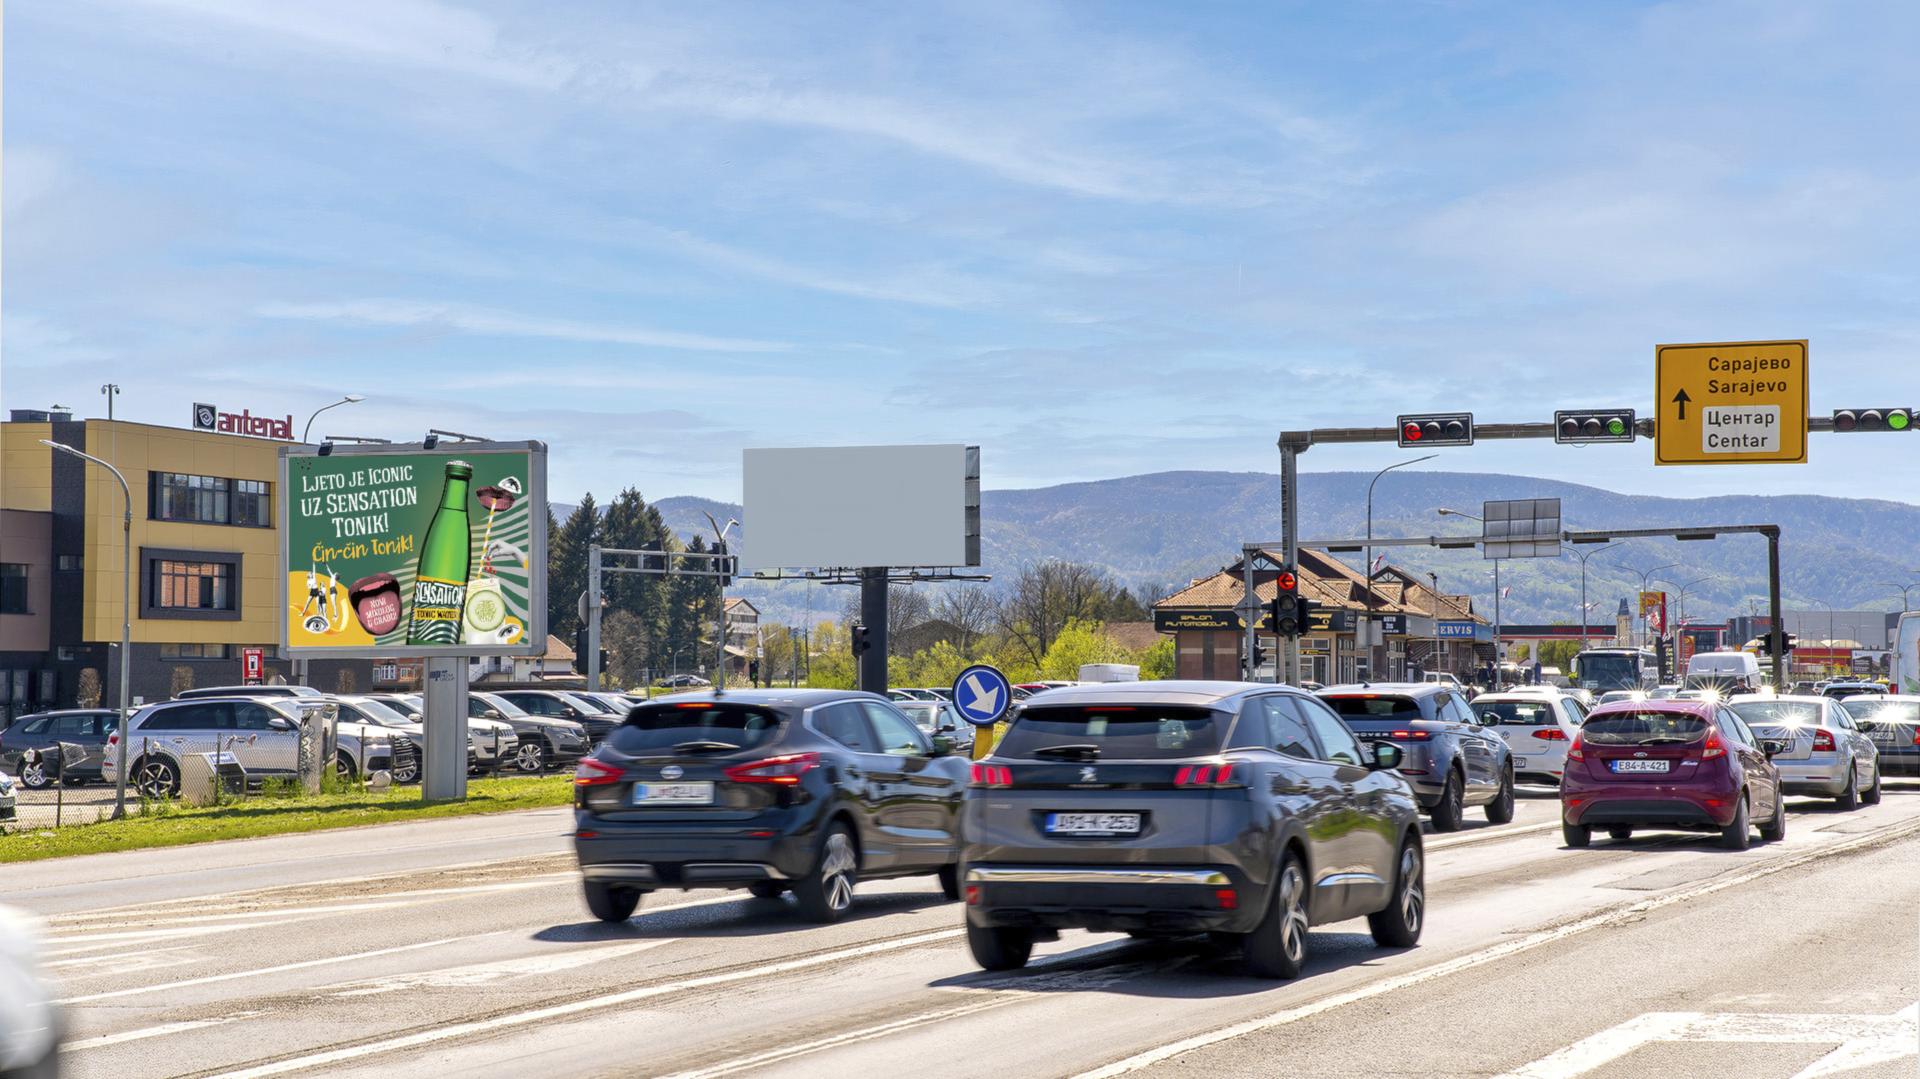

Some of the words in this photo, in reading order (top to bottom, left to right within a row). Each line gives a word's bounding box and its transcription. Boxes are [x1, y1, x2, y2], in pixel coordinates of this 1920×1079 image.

[1708, 356, 1791, 374] Сарајево
[1708, 379, 1787, 396] Sarajevo
[217, 408, 295, 440] antenal
[1707, 410, 1775, 428] Центар
[1708, 433, 1768, 448] Centar
[302, 473, 345, 493] LJETO
[348, 470, 365, 488] JE
[368, 465, 413, 485] ICONIC
[301, 497, 323, 517] UZ
[326, 486, 417, 514] SENSATION
[332, 512, 389, 538] TONIK!
[416, 610, 436, 619] TONIC
[1618, 761, 1667, 770] E84-A-421
